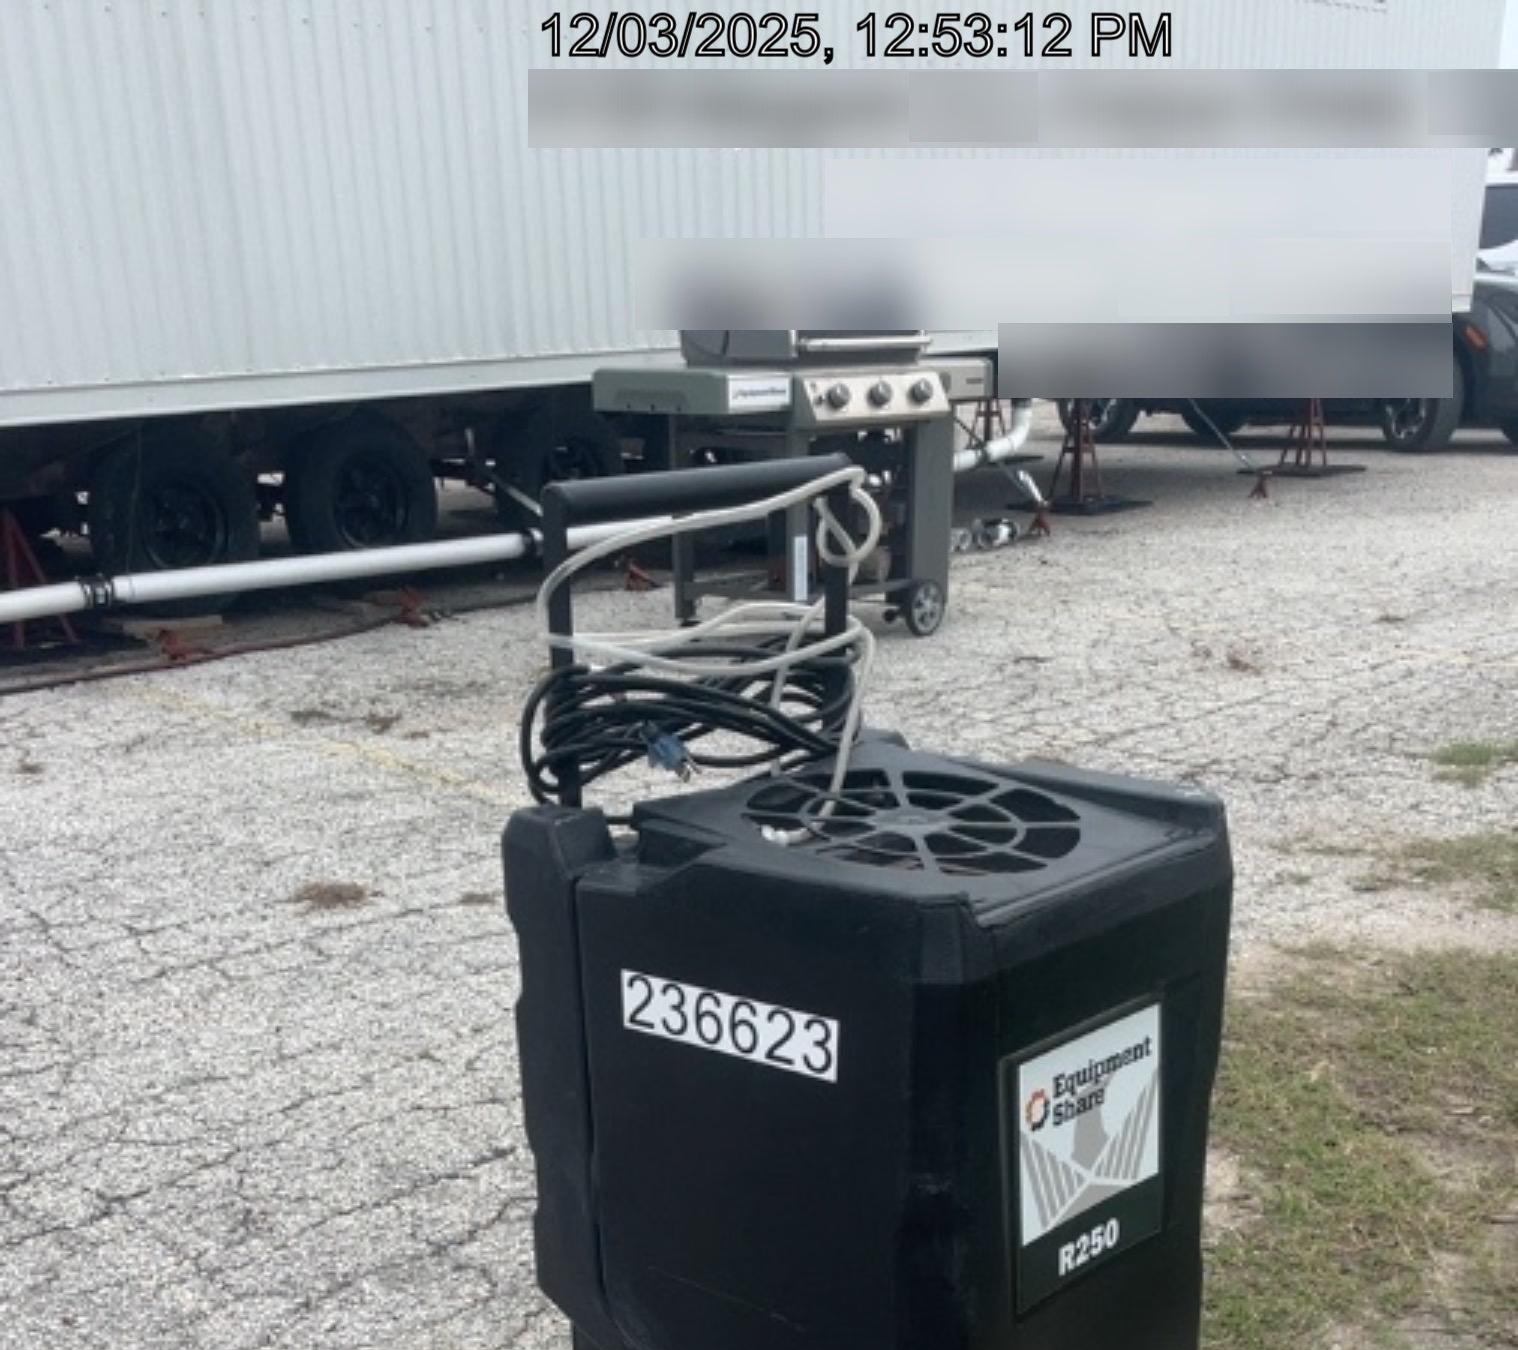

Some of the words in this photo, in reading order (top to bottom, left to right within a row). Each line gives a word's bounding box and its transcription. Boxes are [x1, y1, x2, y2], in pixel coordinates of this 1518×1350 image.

[627, 974, 832, 1074] 236623
[1052, 1037, 1153, 1099] Equipment
[1052, 1086, 1105, 1126] Share
[1058, 1217, 1120, 1277] R250
